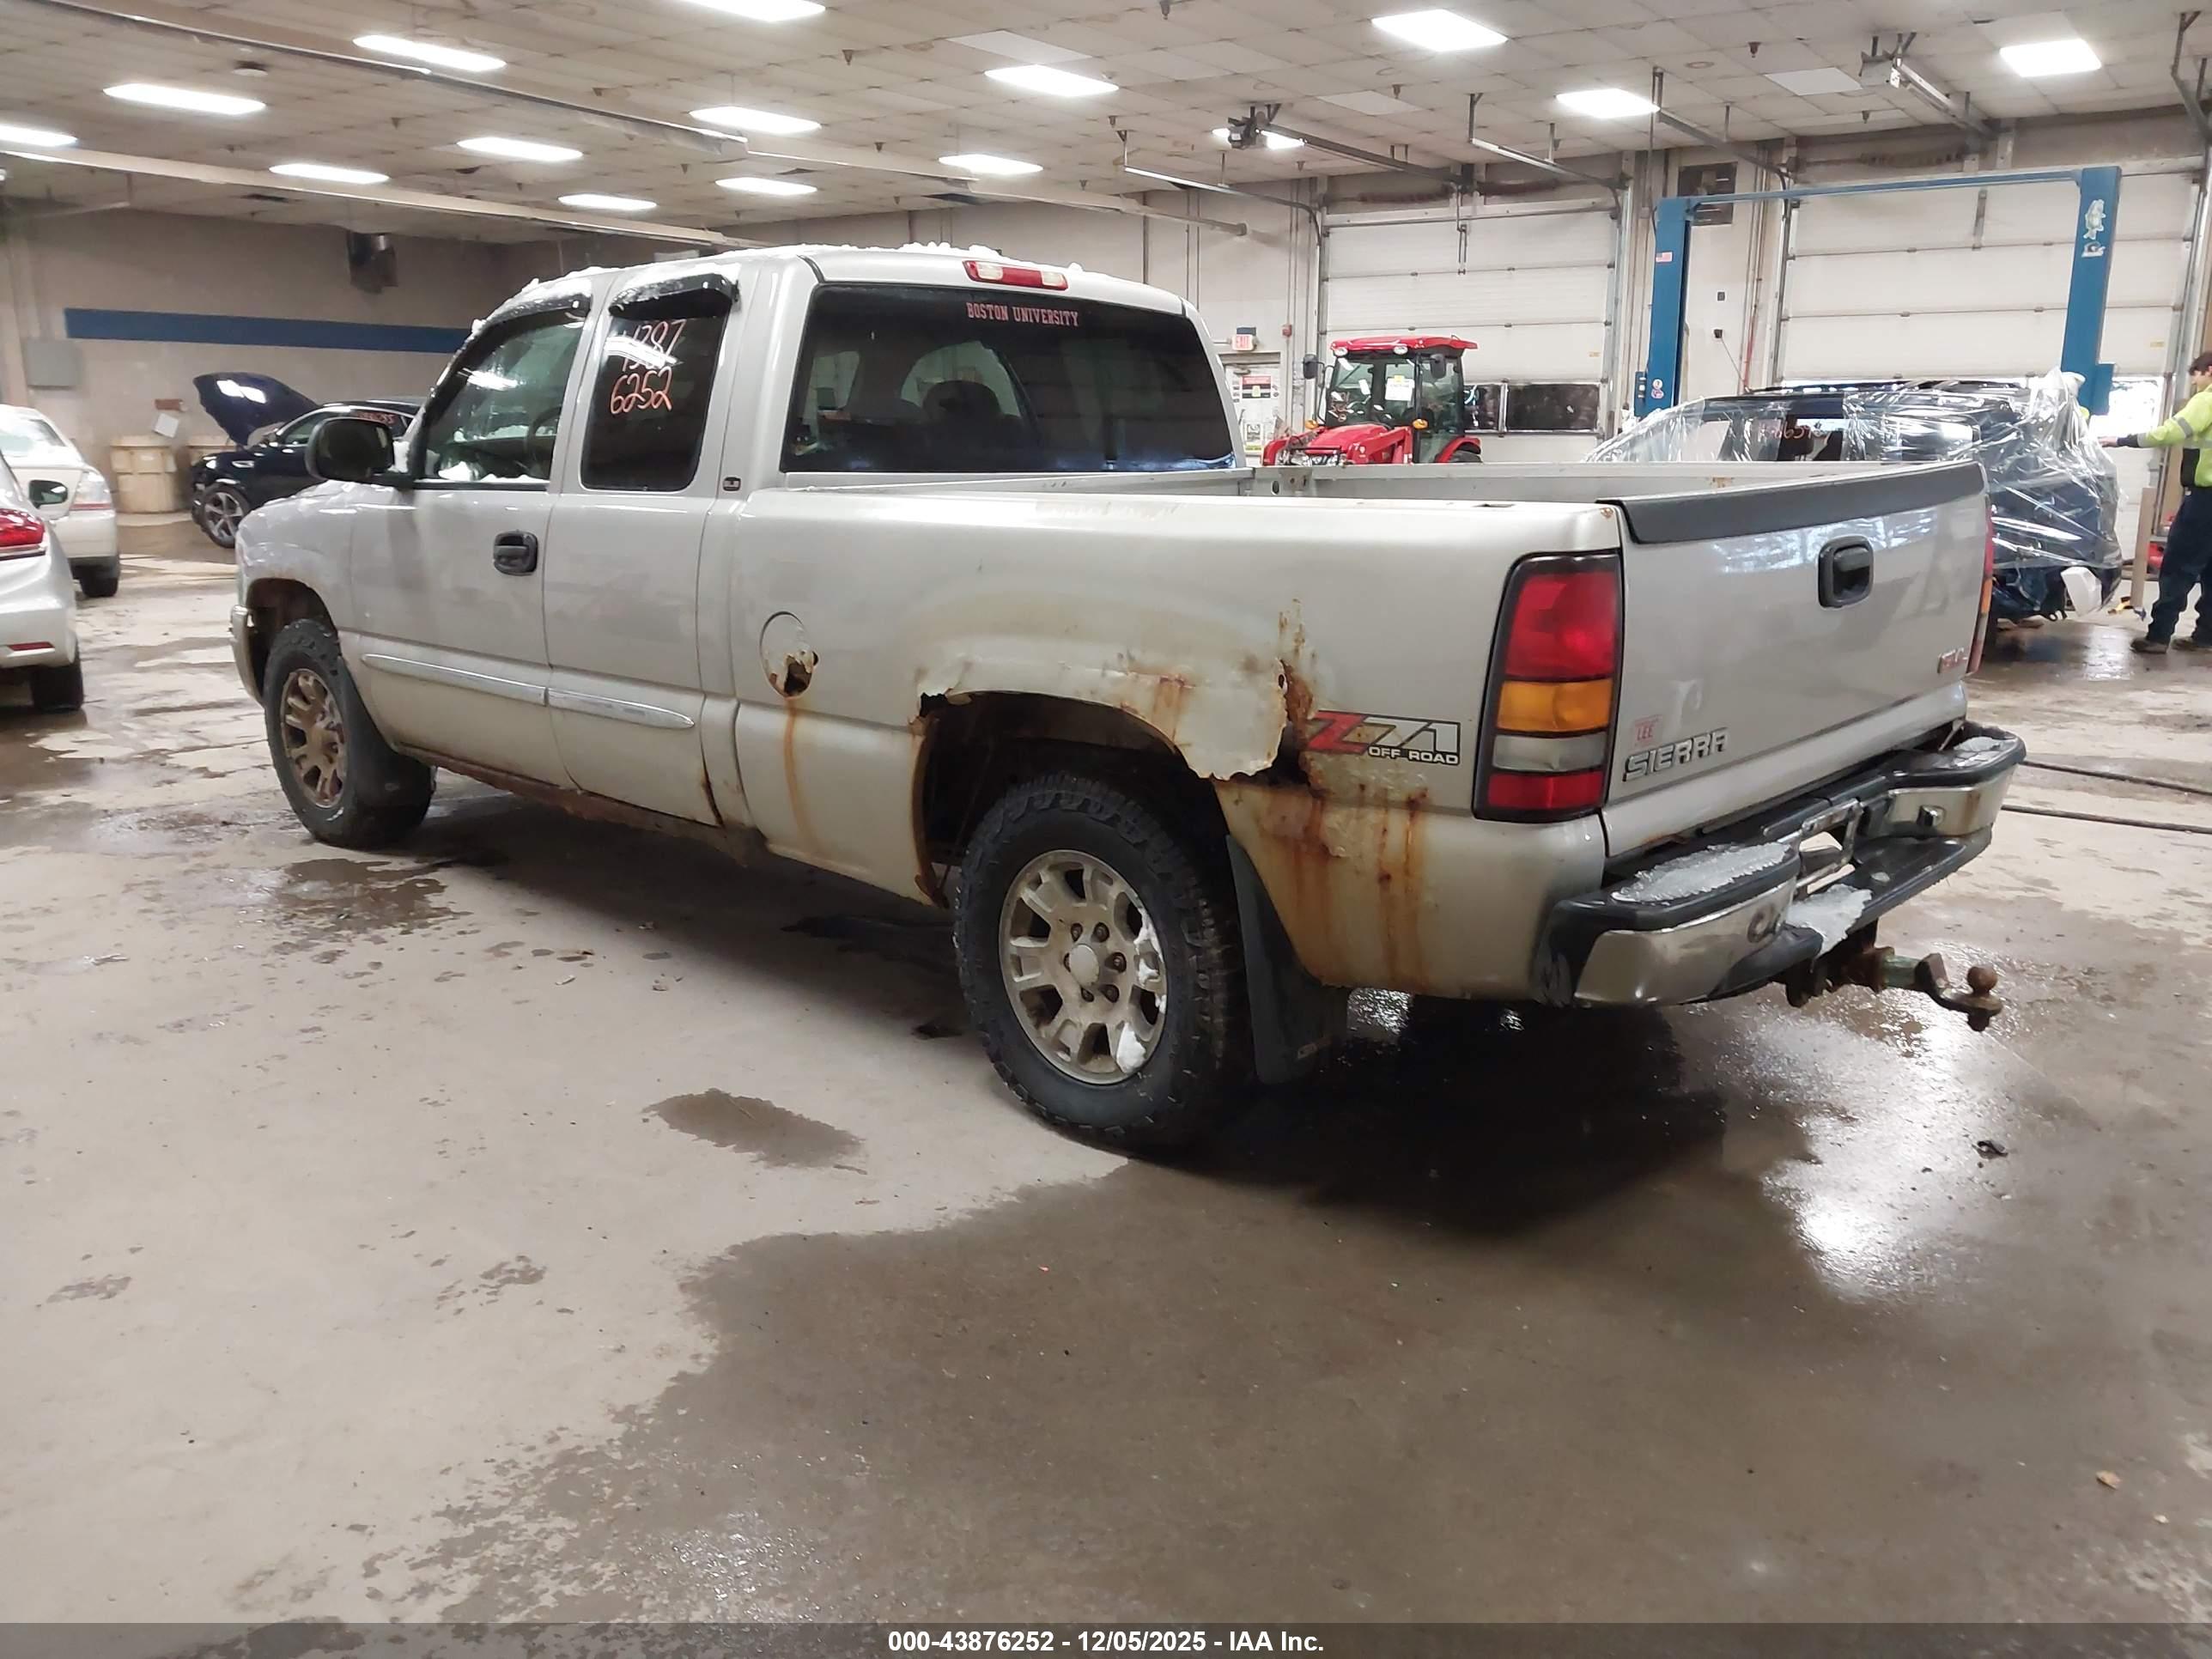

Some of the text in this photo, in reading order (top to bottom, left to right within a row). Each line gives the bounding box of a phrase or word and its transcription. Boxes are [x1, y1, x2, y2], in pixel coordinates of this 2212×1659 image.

[966, 302, 1079, 326] BOSTON UNIVERSITY
[611, 366, 672, 415] 6252
[1307, 710, 1461, 756] Z71
[1368, 745, 1460, 765] OFF ROAD
[1622, 726, 1729, 781] SIERRA
